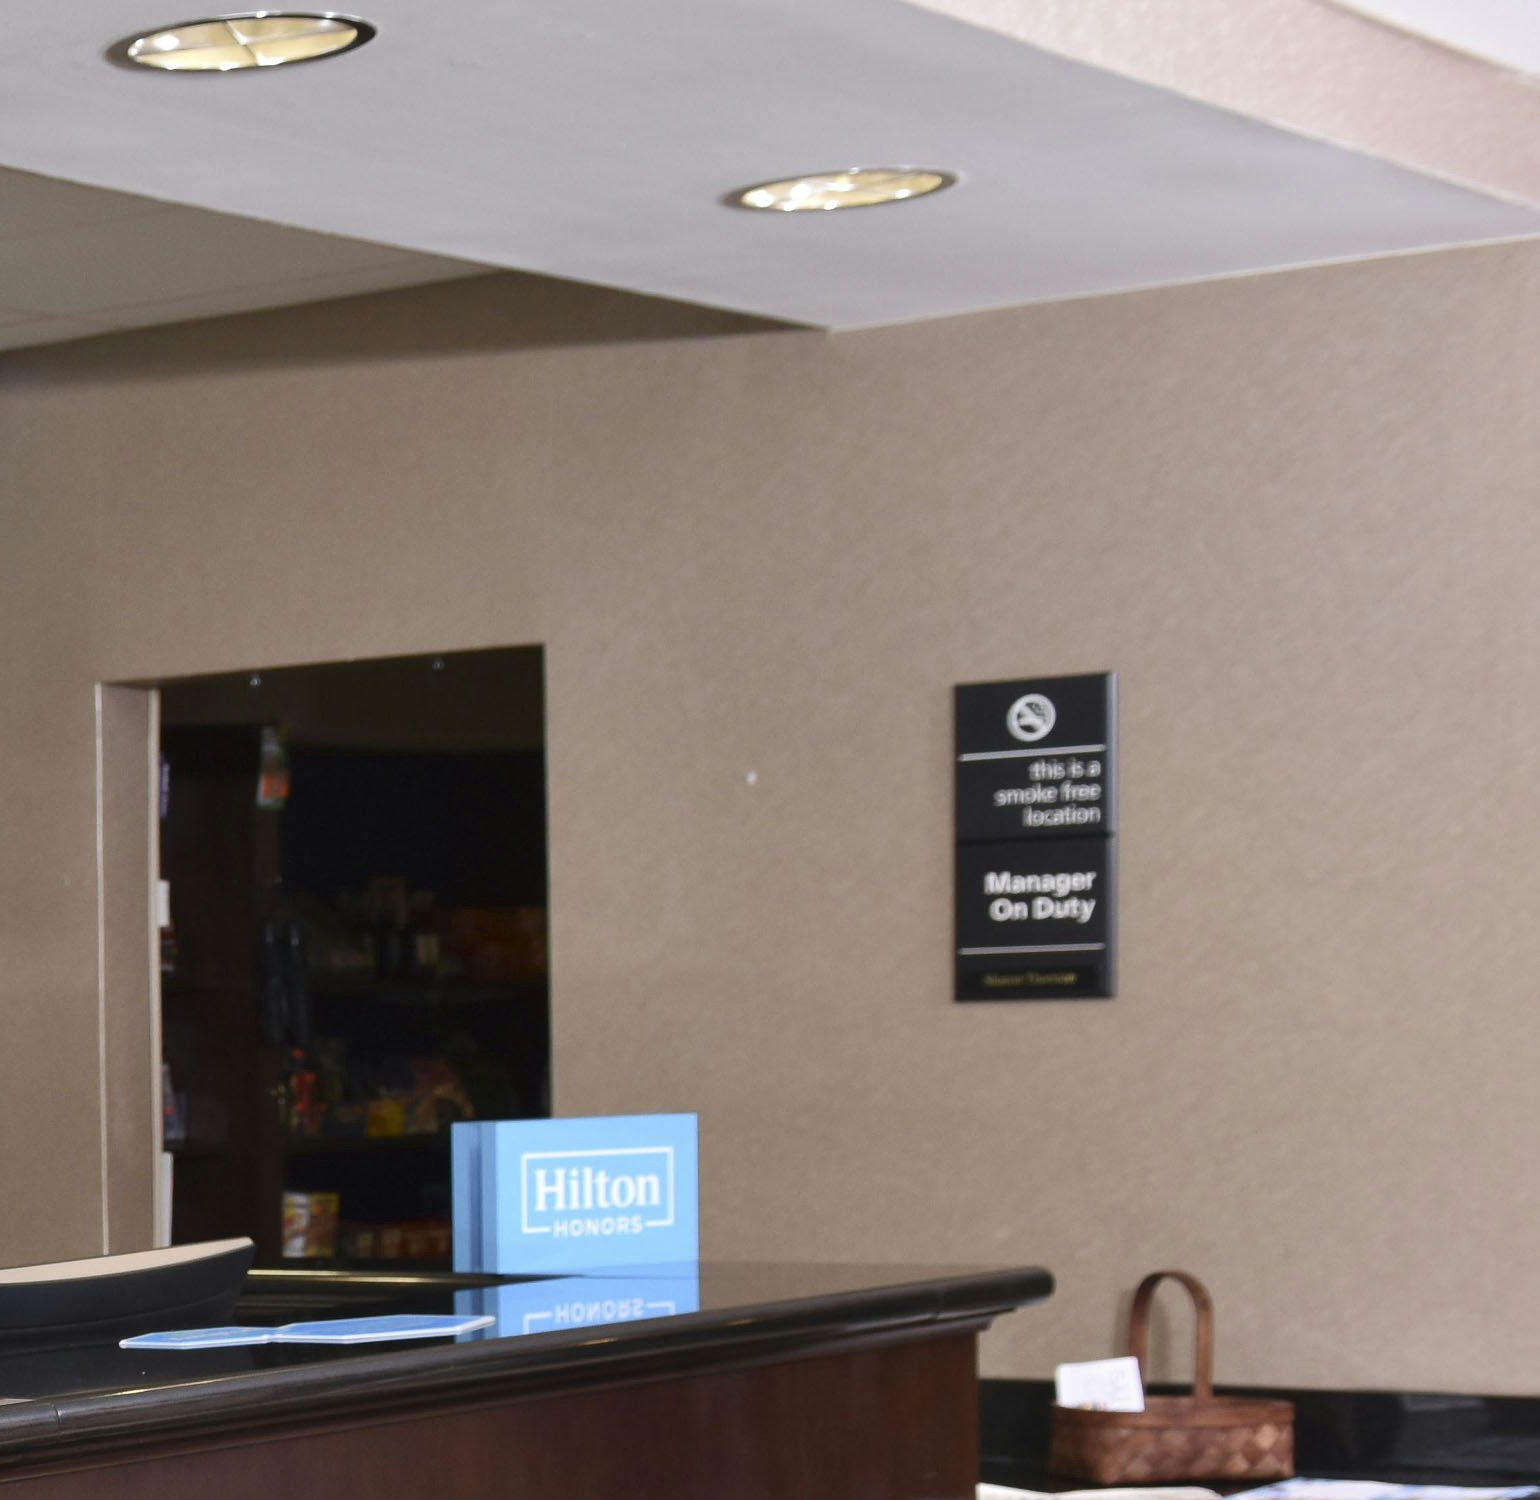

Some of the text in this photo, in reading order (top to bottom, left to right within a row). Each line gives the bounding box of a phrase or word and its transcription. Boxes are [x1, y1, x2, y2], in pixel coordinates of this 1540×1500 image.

[1028, 758, 1102, 781] this is a
[993, 780, 1102, 806] smoke free
[1022, 804, 1102, 827] location
[983, 871, 1097, 897] Manager
[988, 896, 1097, 923] On Duty
[534, 1166, 661, 1213] Hilton
[552, 1215, 644, 1238] HONORS
